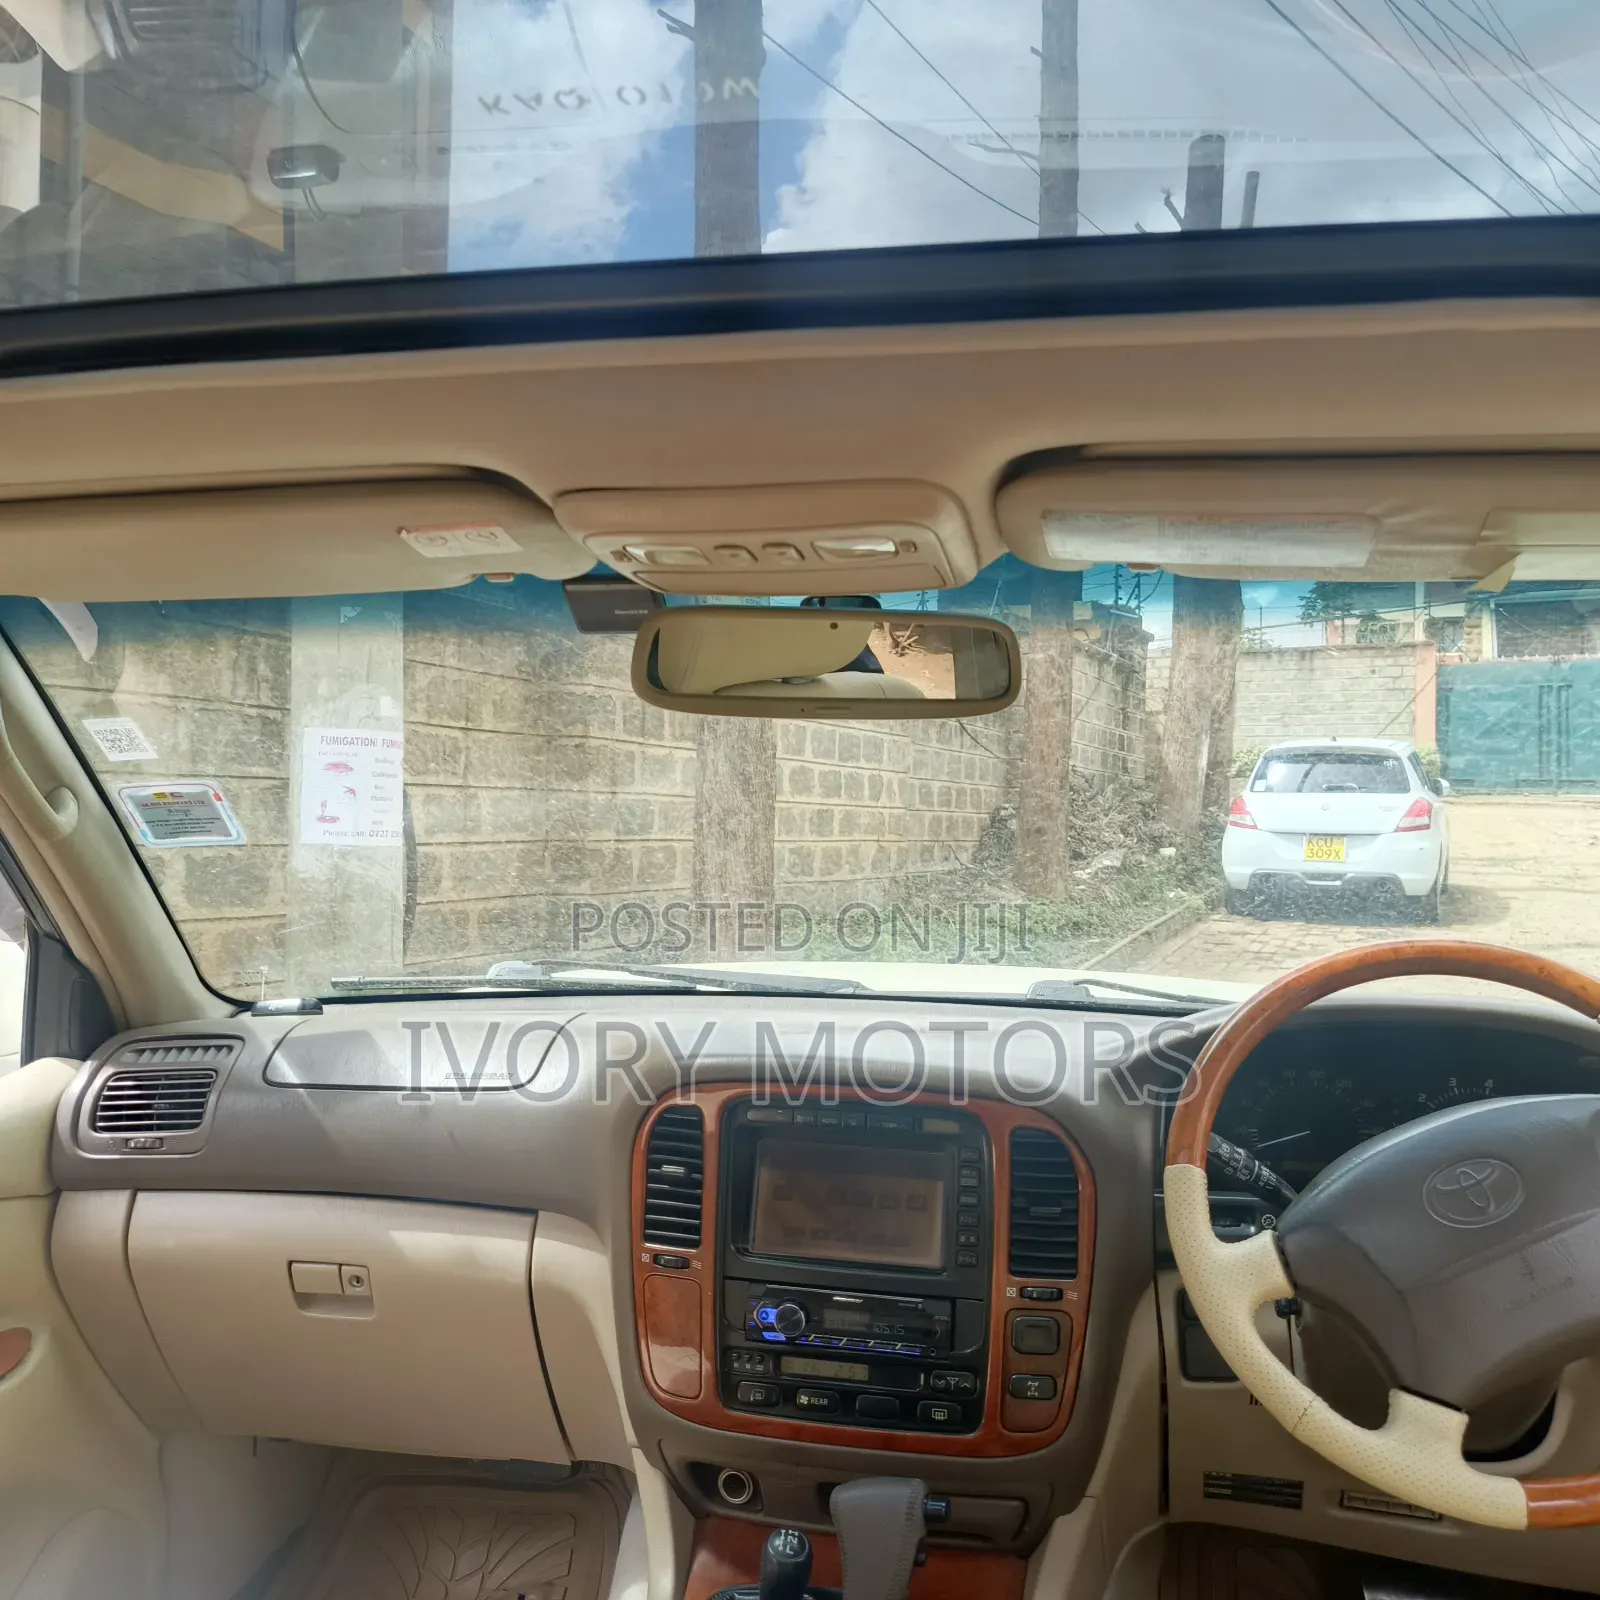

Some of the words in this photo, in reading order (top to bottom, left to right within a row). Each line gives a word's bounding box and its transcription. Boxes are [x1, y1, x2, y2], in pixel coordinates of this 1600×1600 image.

[1307, 836, 1334, 848] KCU
[1306, 848, 1341, 860] 309X
[1449, 1077, 1457, 1086] 3
[1484, 1079, 1494, 1088] 4
[1417, 1093, 1427, 1102] 2
[810, 1396, 828, 1406] REAR
